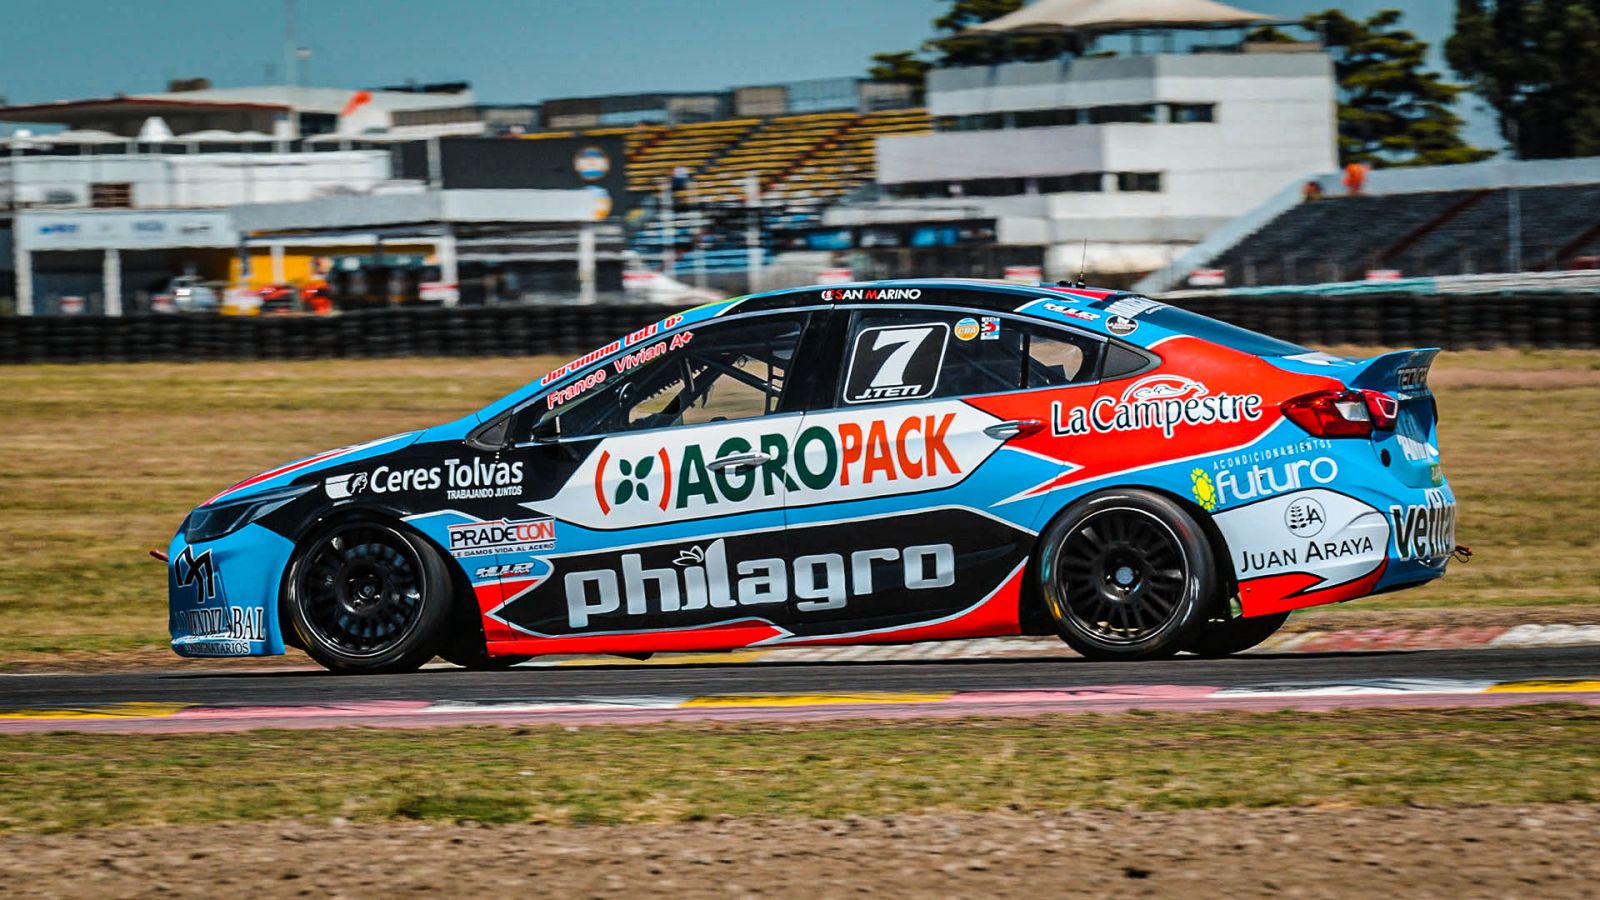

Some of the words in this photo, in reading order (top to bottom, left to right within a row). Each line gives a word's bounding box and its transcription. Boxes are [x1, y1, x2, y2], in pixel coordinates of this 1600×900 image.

[835, 289, 864, 300] SAN
[865, 288, 922, 300] MARINO
[546, 369, 607, 410] Franco
[613, 341, 667, 374] Vivian
[872, 327, 934, 388] 7
[854, 384, 922, 400] J.TETI
[675, 412, 962, 511] AGROPACK
[1213, 440, 1332, 470] ACONDICIONAMIENTOS
[370, 466, 442, 493] Ceres
[445, 457, 523, 488] Tolvas
[447, 487, 494, 500] TRABAJANDO
[494, 486, 523, 498] JUNTOS
[1215, 456, 1338, 504] futuro
[450, 521, 554, 548] PRADECON
[1241, 548, 1296, 573] JUAN
[1305, 536, 1374, 563] ARAYA
[564, 537, 955, 629] philagro
